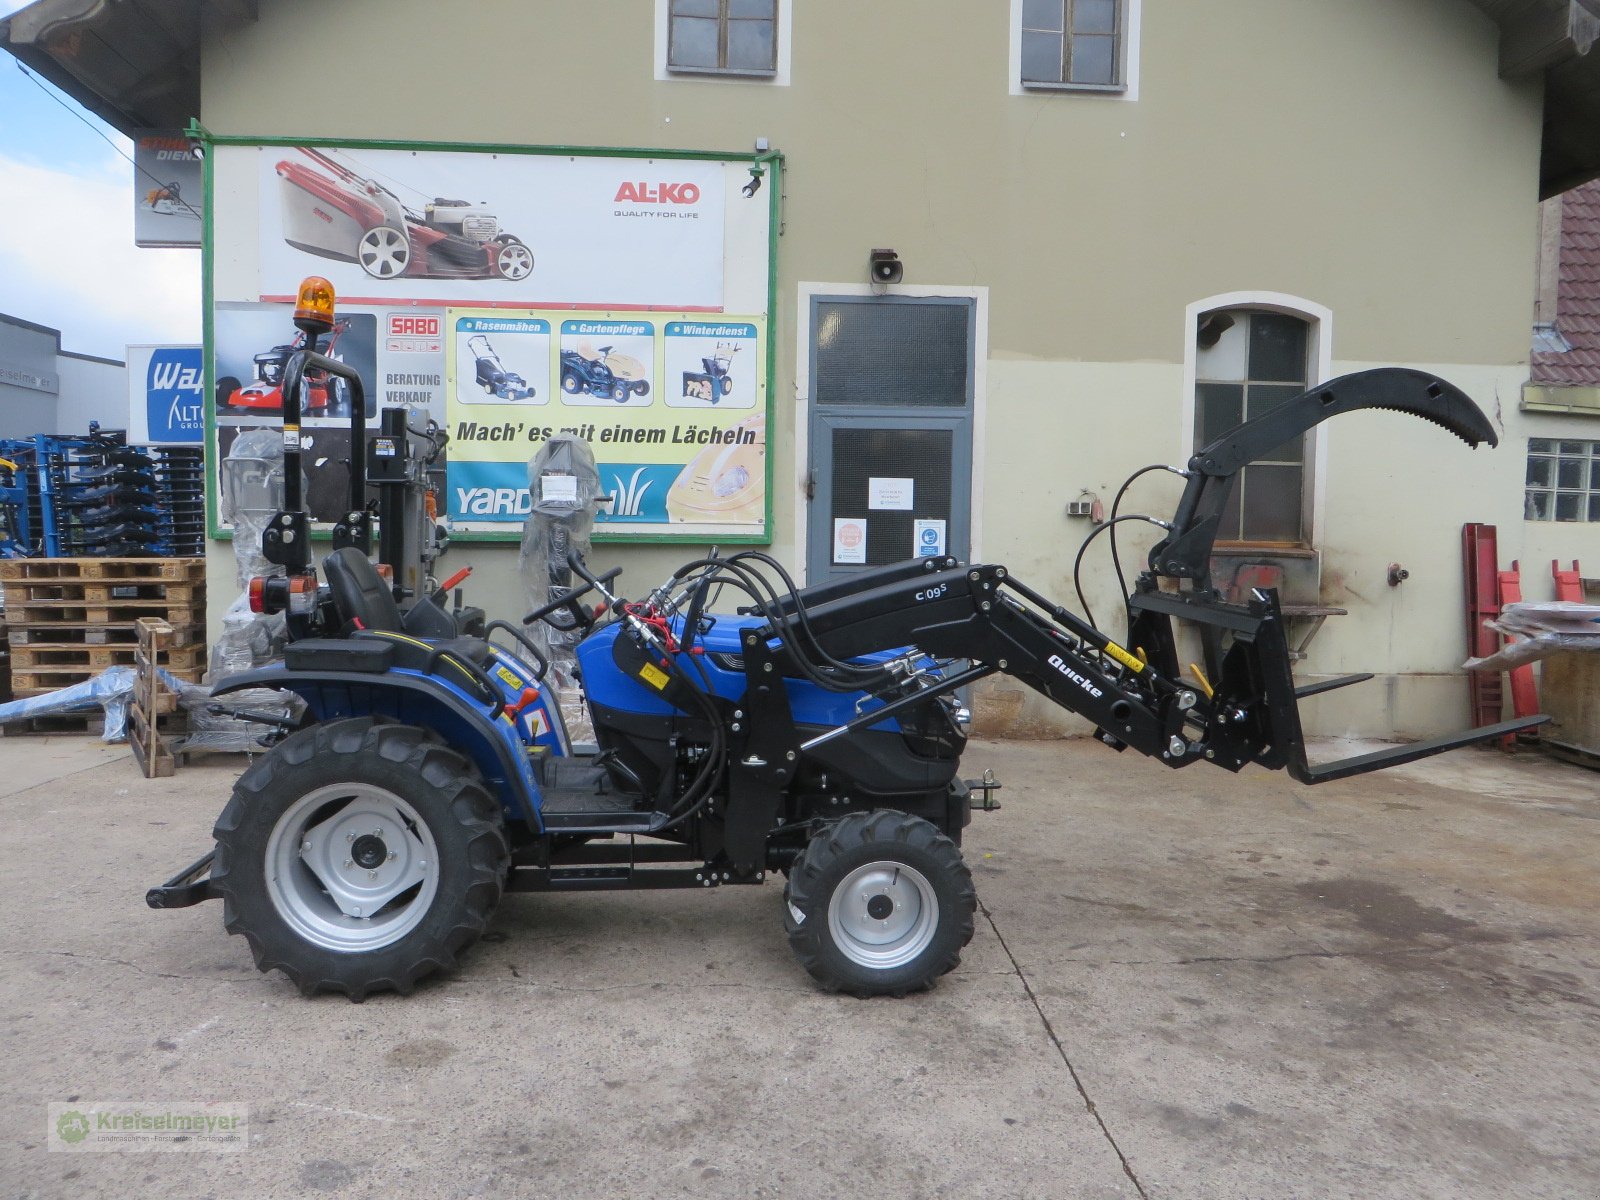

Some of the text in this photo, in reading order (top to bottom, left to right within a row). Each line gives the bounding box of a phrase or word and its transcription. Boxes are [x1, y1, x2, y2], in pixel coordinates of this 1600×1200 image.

[614, 181, 700, 205] AL-KO
[391, 318, 438, 334] SABO
[475, 320, 541, 332] Rasenmähen
[579, 323, 645, 335] Gartenpflege
[683, 325, 748, 336] Winterdienst
[386, 373, 441, 386] BERATUNG
[386, 391, 432, 403] VERKAUF
[528, 426, 553, 442] es
[600, 424, 665, 443] einem
[671, 424, 756, 445] Lächeln
[1047, 654, 1103, 698] Quicke
